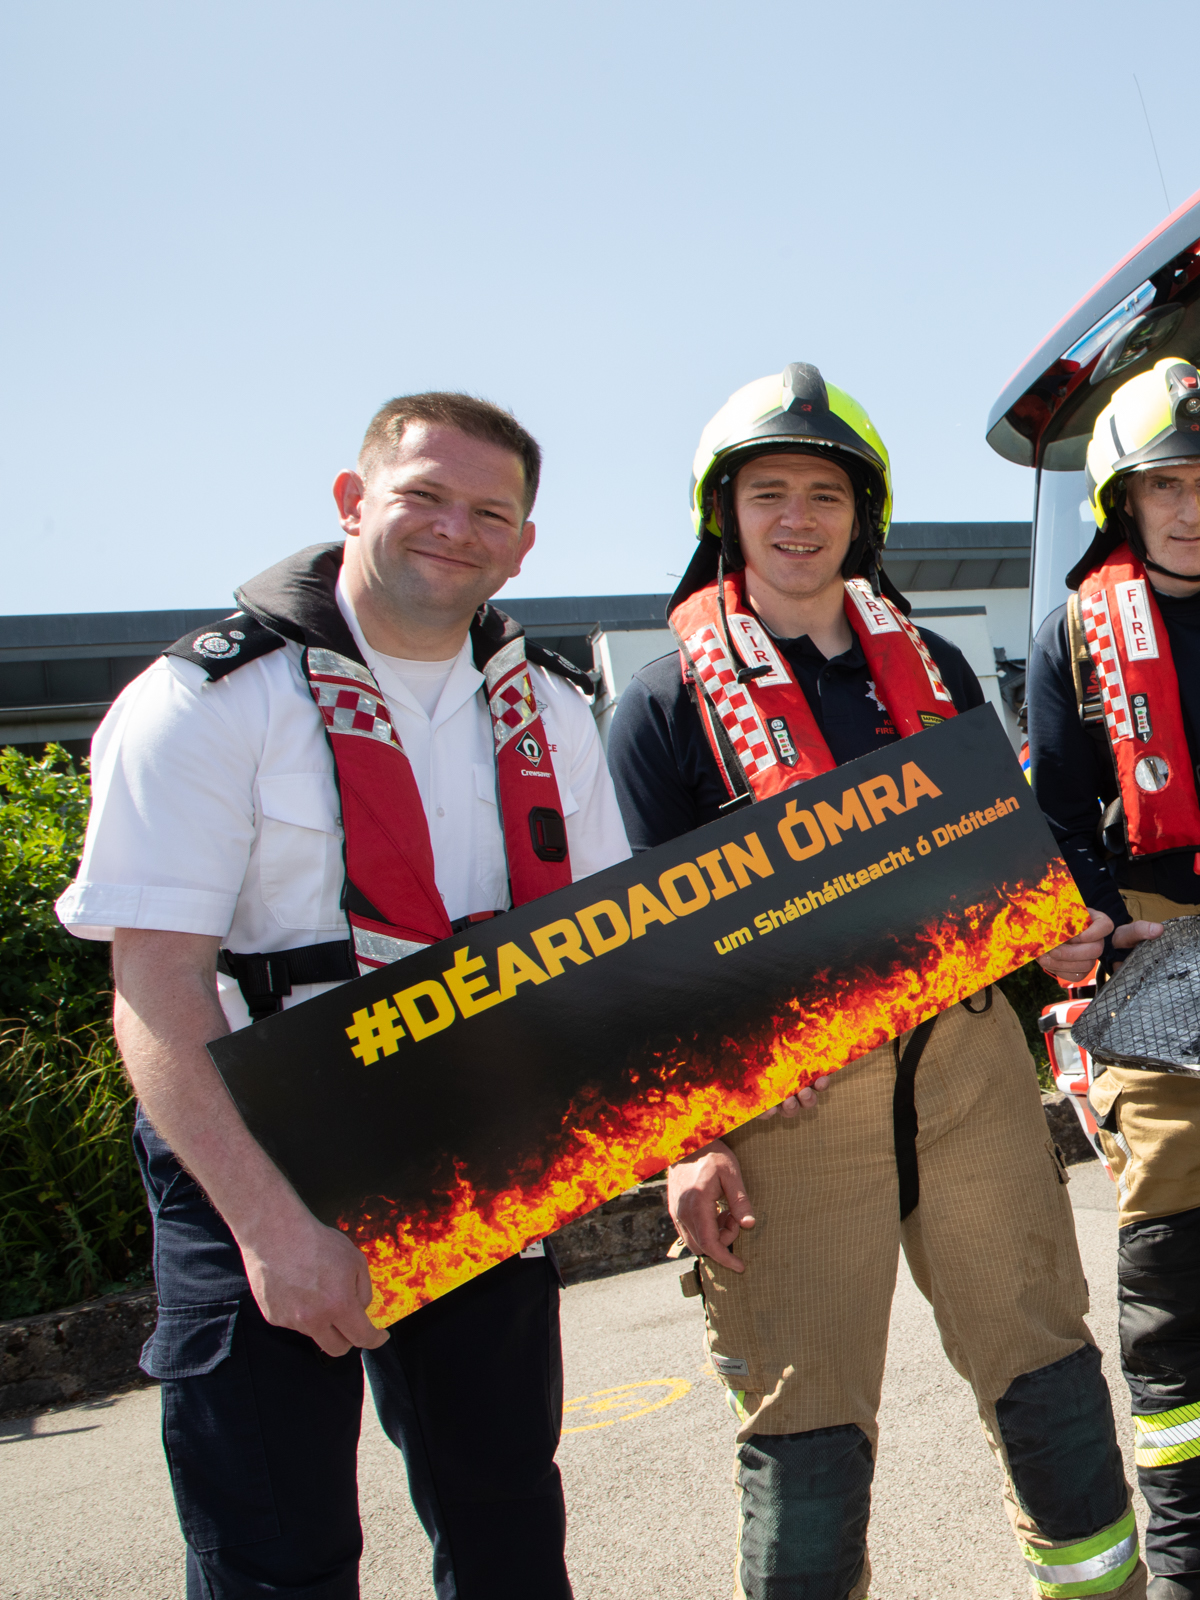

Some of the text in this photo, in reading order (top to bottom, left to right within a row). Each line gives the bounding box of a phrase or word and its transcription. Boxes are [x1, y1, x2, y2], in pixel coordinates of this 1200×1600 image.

[1127, 588, 1148, 651] FIRE
[521, 769, 551, 778] Crewsaver
[345, 760, 943, 1067] #DÉARDAOIN ÓMRA
[713, 796, 1020, 955] um Shábháilteacht ó Dhóiteán
